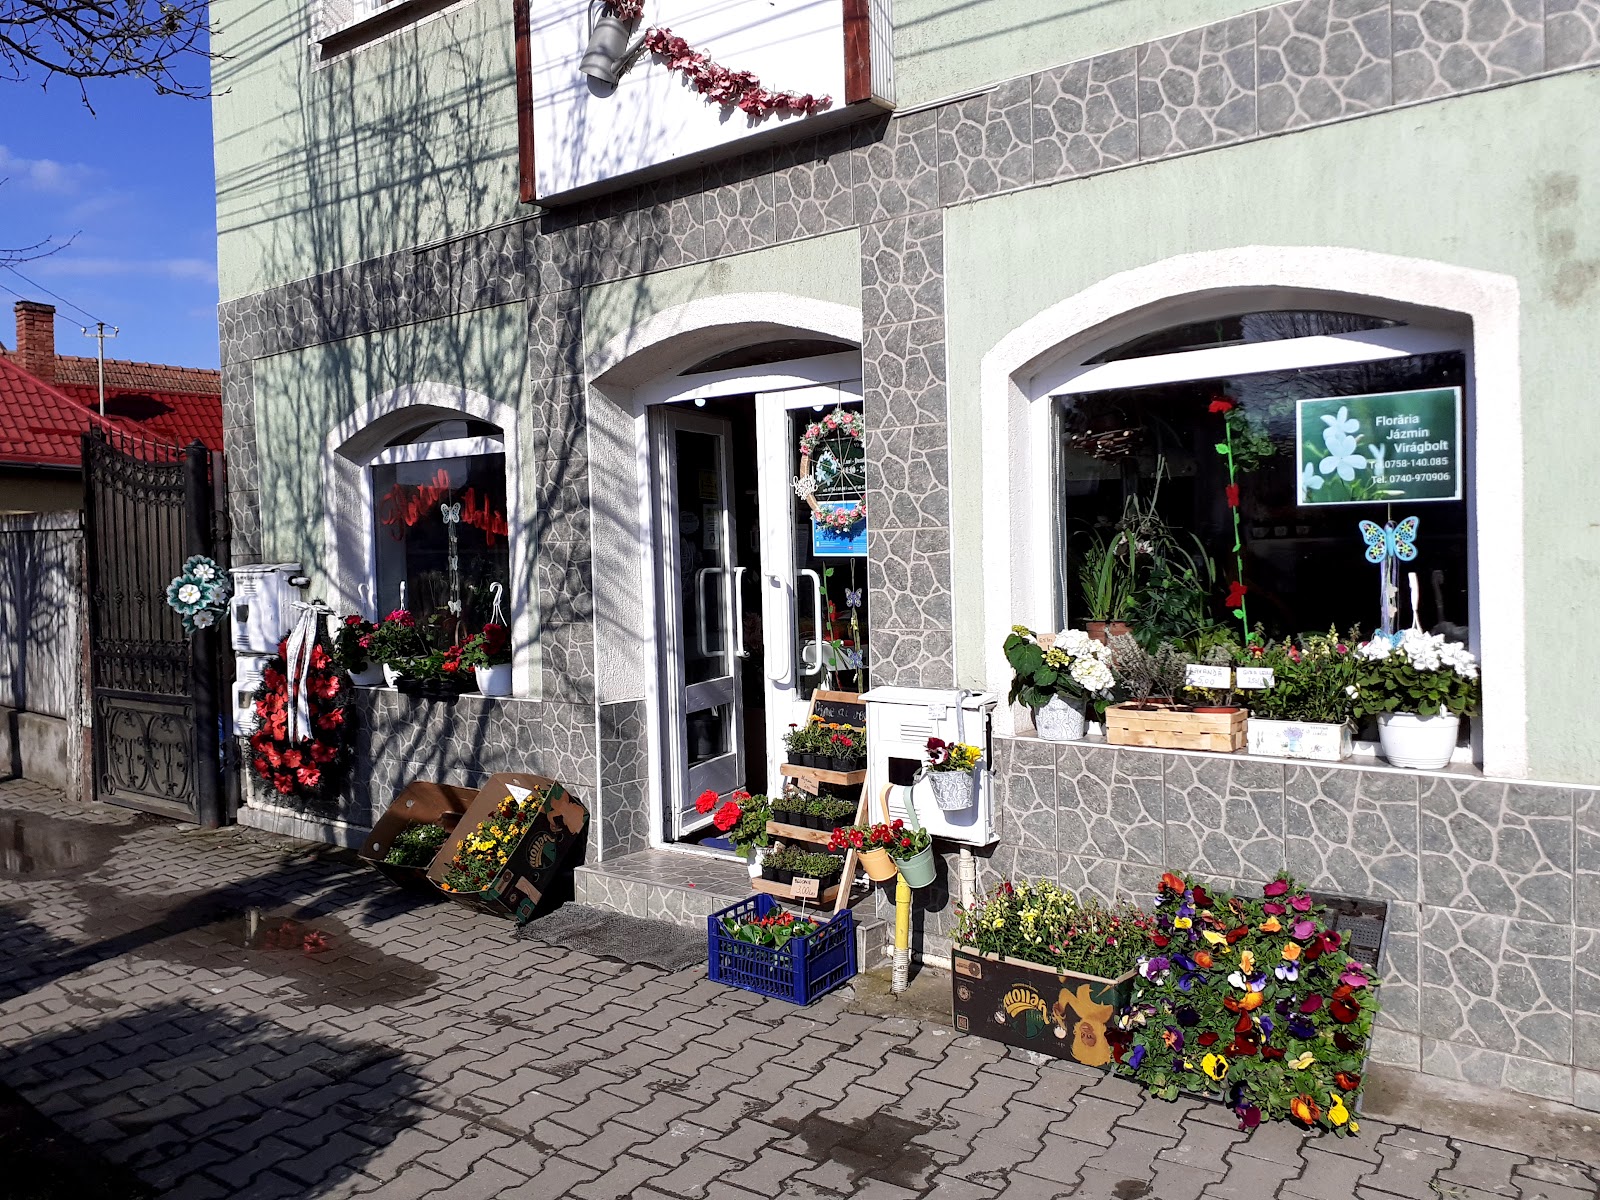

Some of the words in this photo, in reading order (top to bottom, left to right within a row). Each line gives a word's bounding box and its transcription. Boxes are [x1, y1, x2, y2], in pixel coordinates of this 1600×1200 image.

[1376, 414, 1419, 426] Florăria
[1386, 428, 1429, 439] Jázmin
[1394, 440, 1449, 454] Virágbolt
[1370, 457, 1449, 468] T.0758-140.085
[1371, 475, 1386, 485] Tel.
[1390, 472, 1450, 483] 0740-970906
[1003, 988, 1051, 1024] yellow
